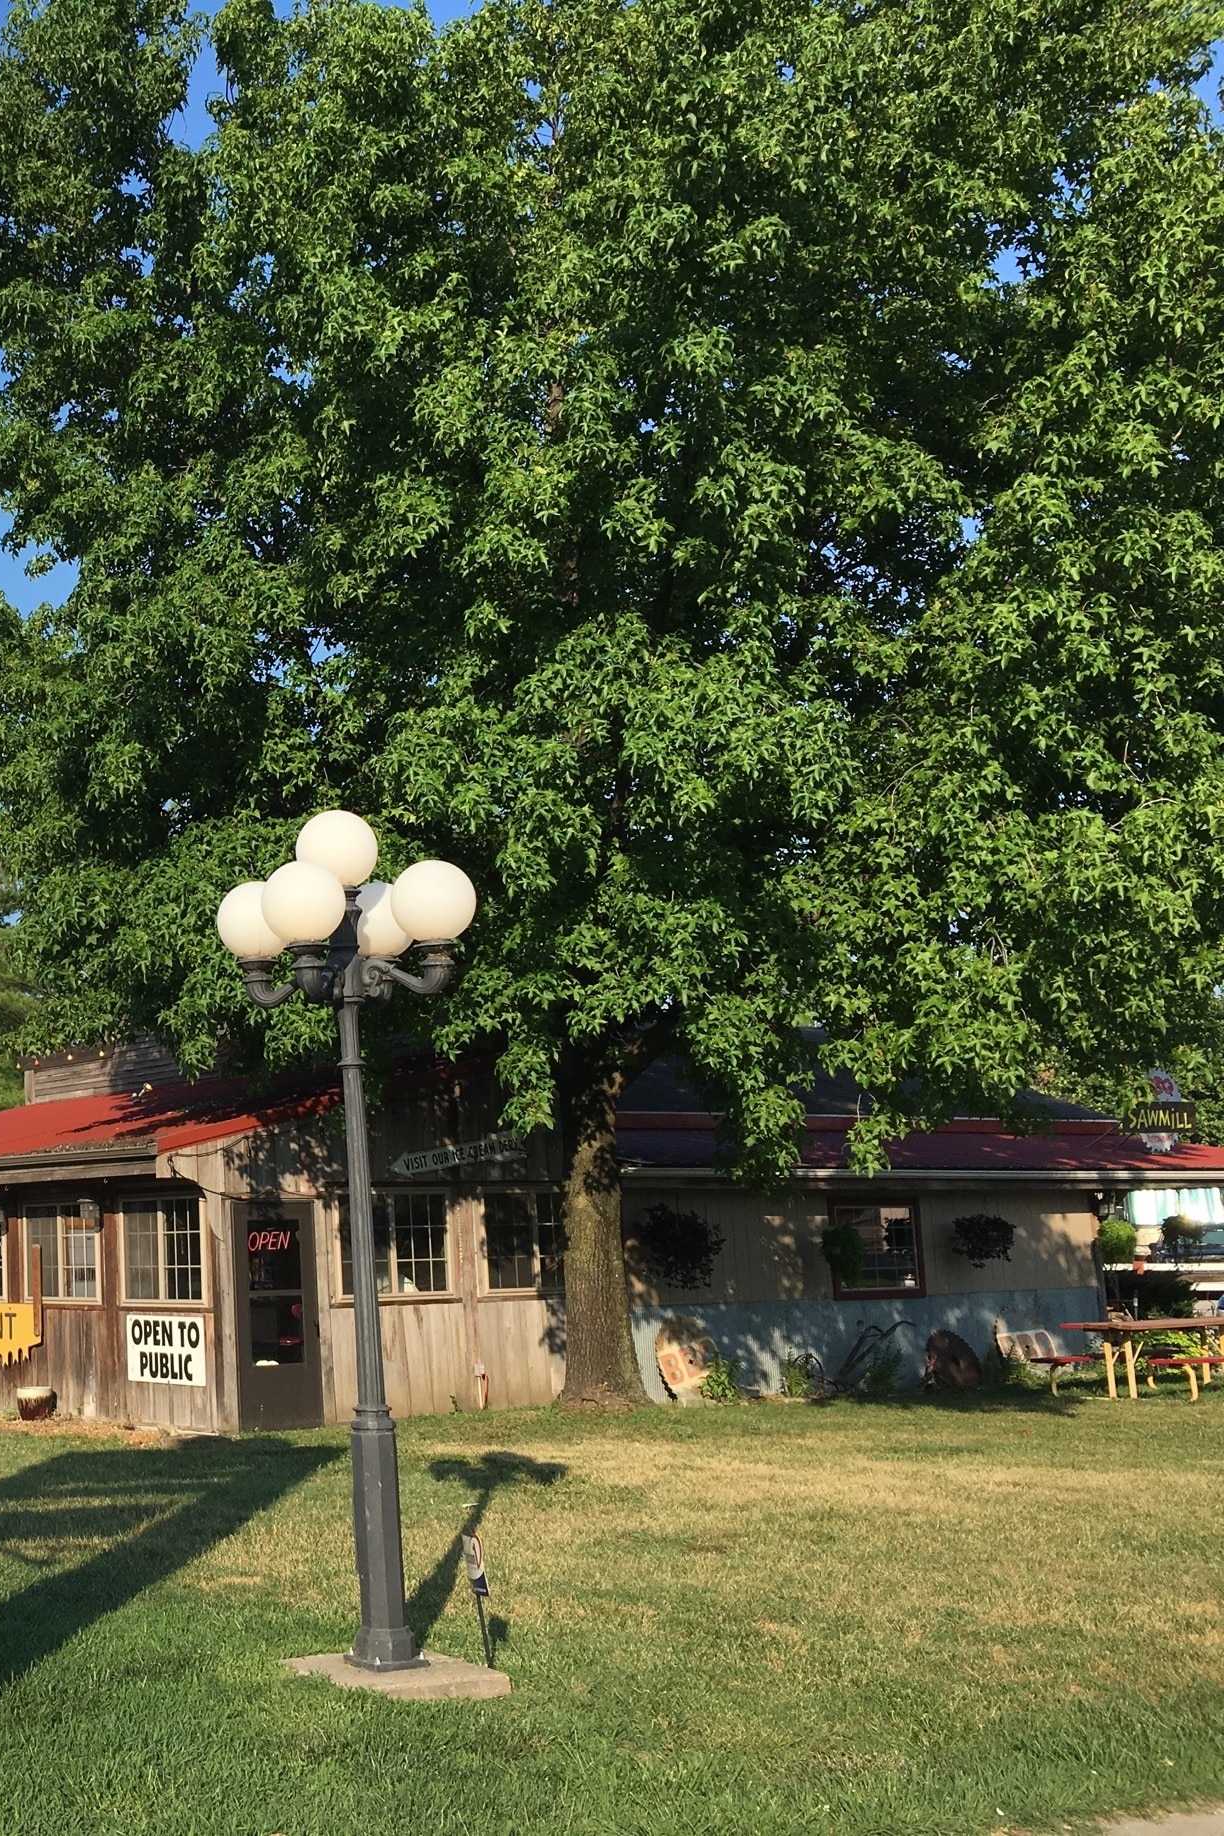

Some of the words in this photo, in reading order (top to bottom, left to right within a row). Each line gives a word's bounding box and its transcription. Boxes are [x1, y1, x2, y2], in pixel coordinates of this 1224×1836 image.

[403, 1155, 427, 1171] VISIT
[432, 1151, 450, 1165] OUR
[453, 1147, 466, 1161] ICE
[468, 1142, 496, 1159] CREAM
[248, 1231, 290, 1251] OPEN
[131, 1319, 173, 1347] OPEN
[178, 1321, 200, 1348] TO
[140, 1351, 193, 1381] PUBLIC
